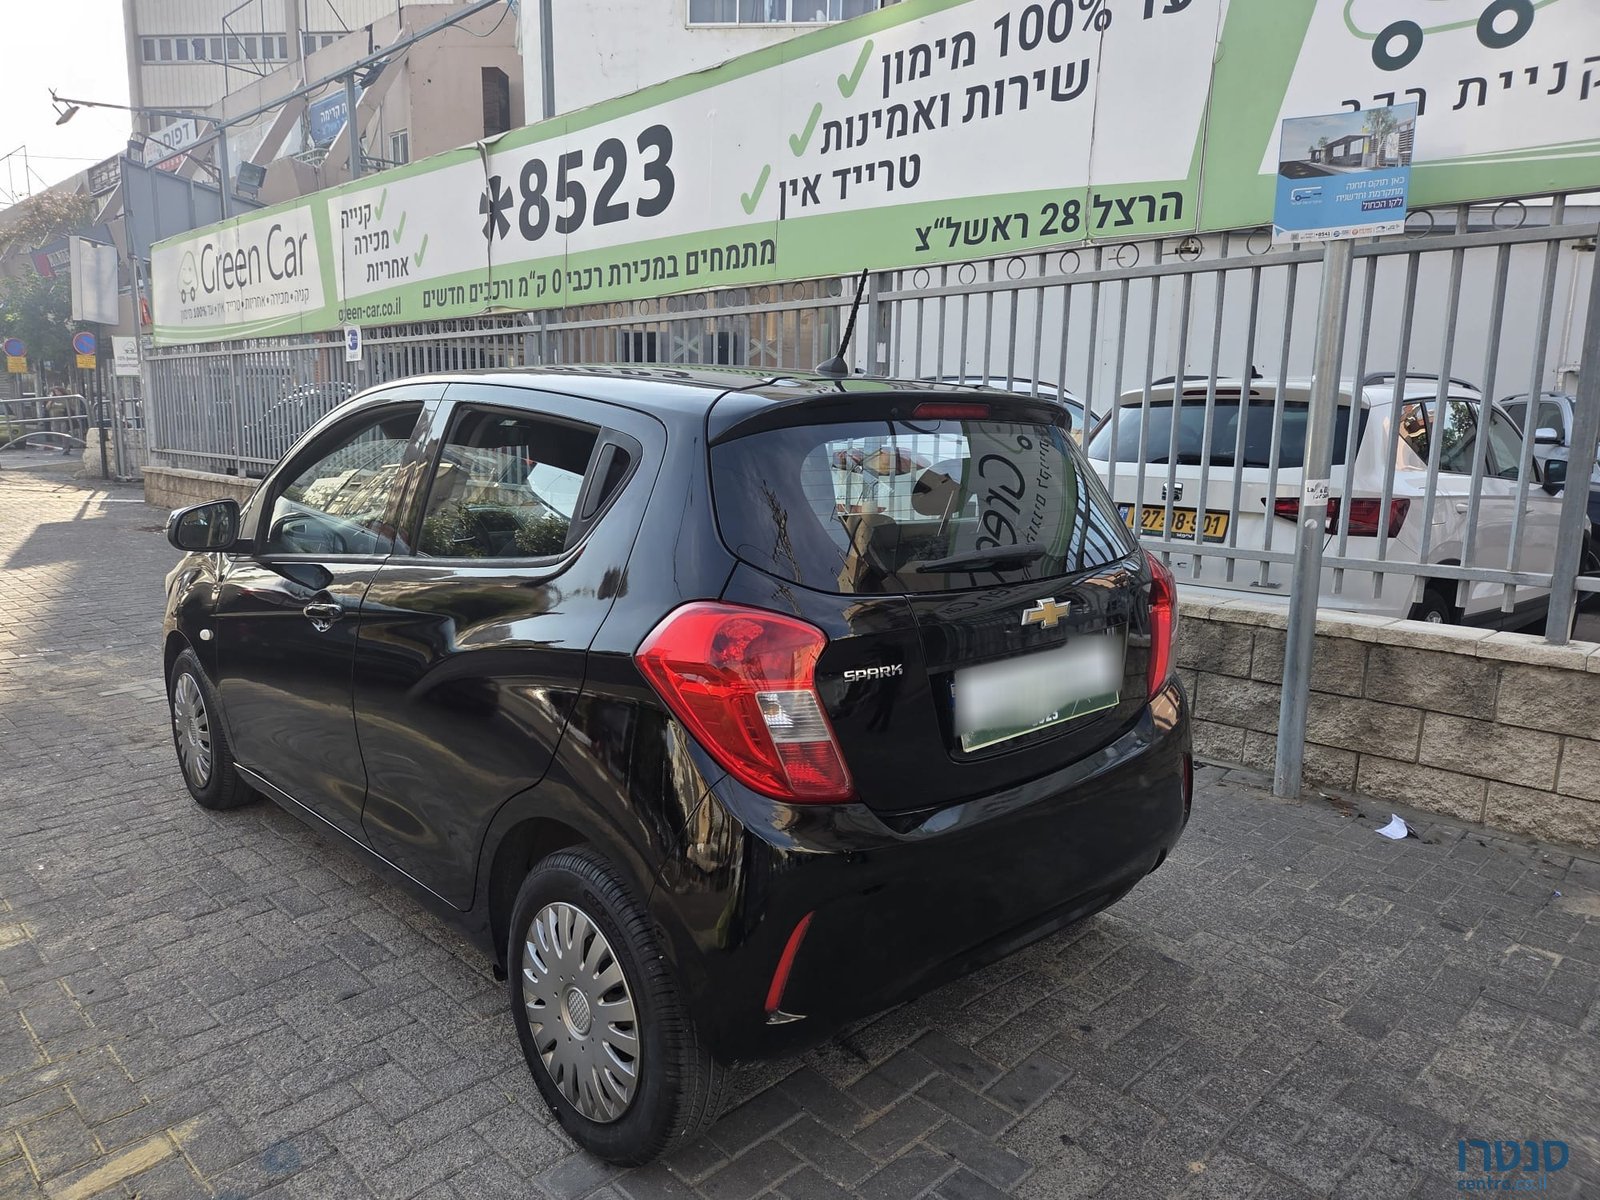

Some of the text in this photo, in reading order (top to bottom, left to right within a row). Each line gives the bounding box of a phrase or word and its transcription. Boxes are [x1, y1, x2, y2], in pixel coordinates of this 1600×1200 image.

[881, 0, 1112, 99] 100% מימון
[820, 58, 1091, 155] שירות ואמינות
[778, 153, 922, 221] טרייד אין
[1391, 176, 1405, 186] כאן
[341, 203, 372, 230] קנייה
[354, 230, 390, 256] מכירה
[914, 191, 1184, 252] הרצל 28 ראשל"צ
[201, 223, 308, 294] Green Car
[366, 256, 409, 283] אחריות
[422, 238, 776, 309] מתמחים במכירת רכבי 0 ק"מ ורכבים חדשים
[843, 663, 903, 683] SPARK
